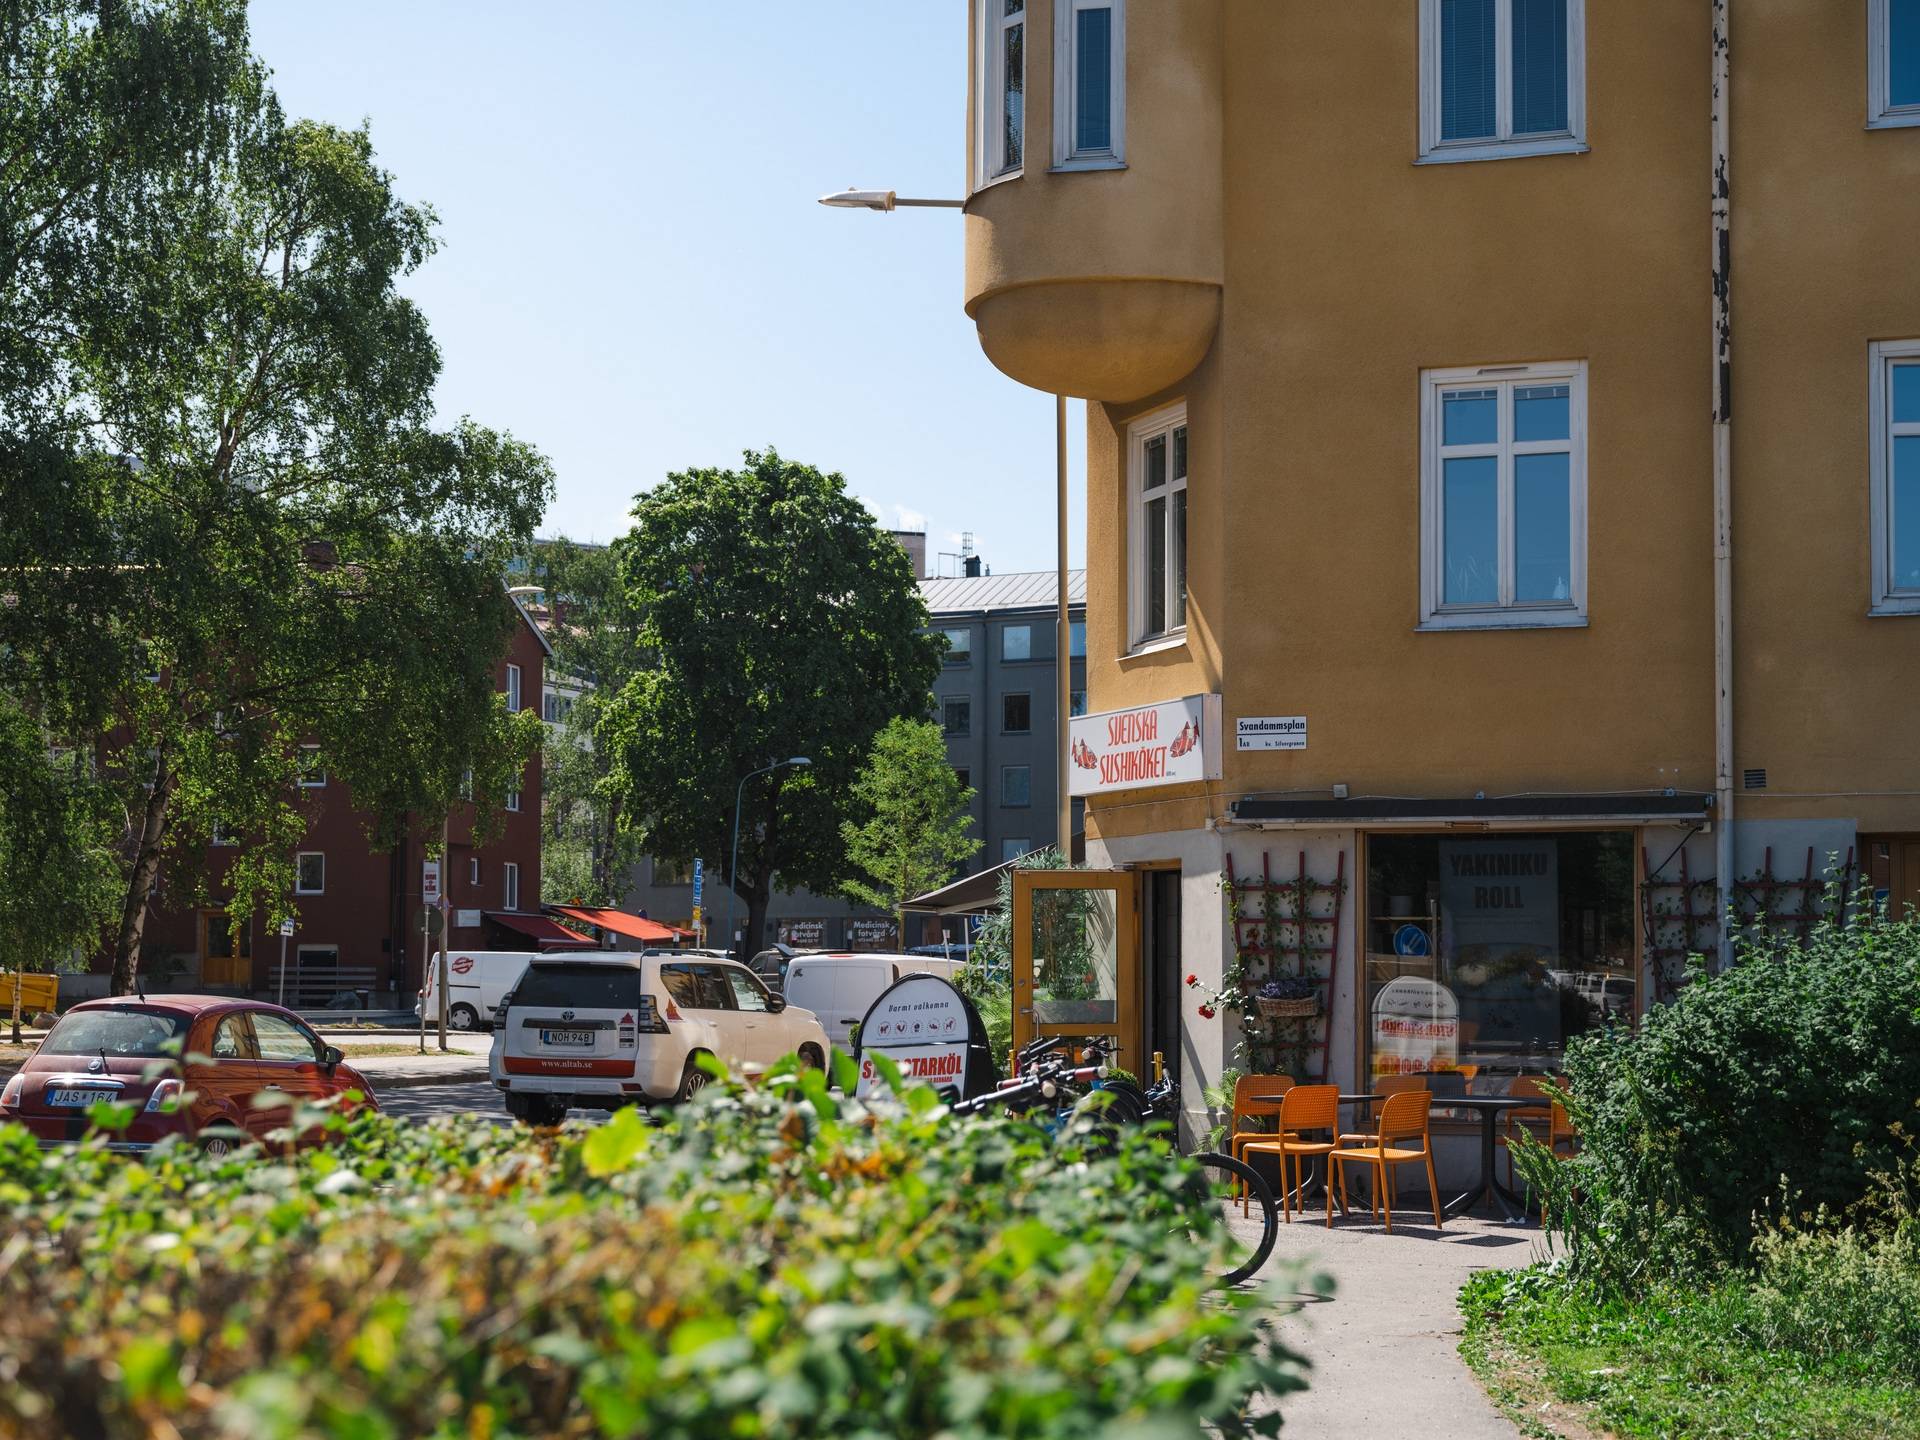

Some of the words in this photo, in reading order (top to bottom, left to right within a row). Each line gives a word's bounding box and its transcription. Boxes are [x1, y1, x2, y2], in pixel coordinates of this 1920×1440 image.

[1107, 709, 1158, 747] SVENSKA
[1239, 719, 1305, 732] Svandammsplan
[1099, 746, 1168, 785] SUSHIKÖKET
[695, 861, 702, 875] P
[1450, 853, 1548, 876] YAKINIKU
[1474, 886, 1525, 909] ROLL
[792, 921, 823, 929] edicinsk
[853, 920, 890, 929] Medicinsk
[795, 929, 819, 938] otvård
[858, 928, 886, 937] fotvård
[888, 1004, 911, 1013] Varmt
[914, 1001, 949, 1010] välkomna
[551, 1031, 569, 1041] NOH
[54, 1092, 80, 1102] JAS
[91, 1092, 114, 1103] 164
